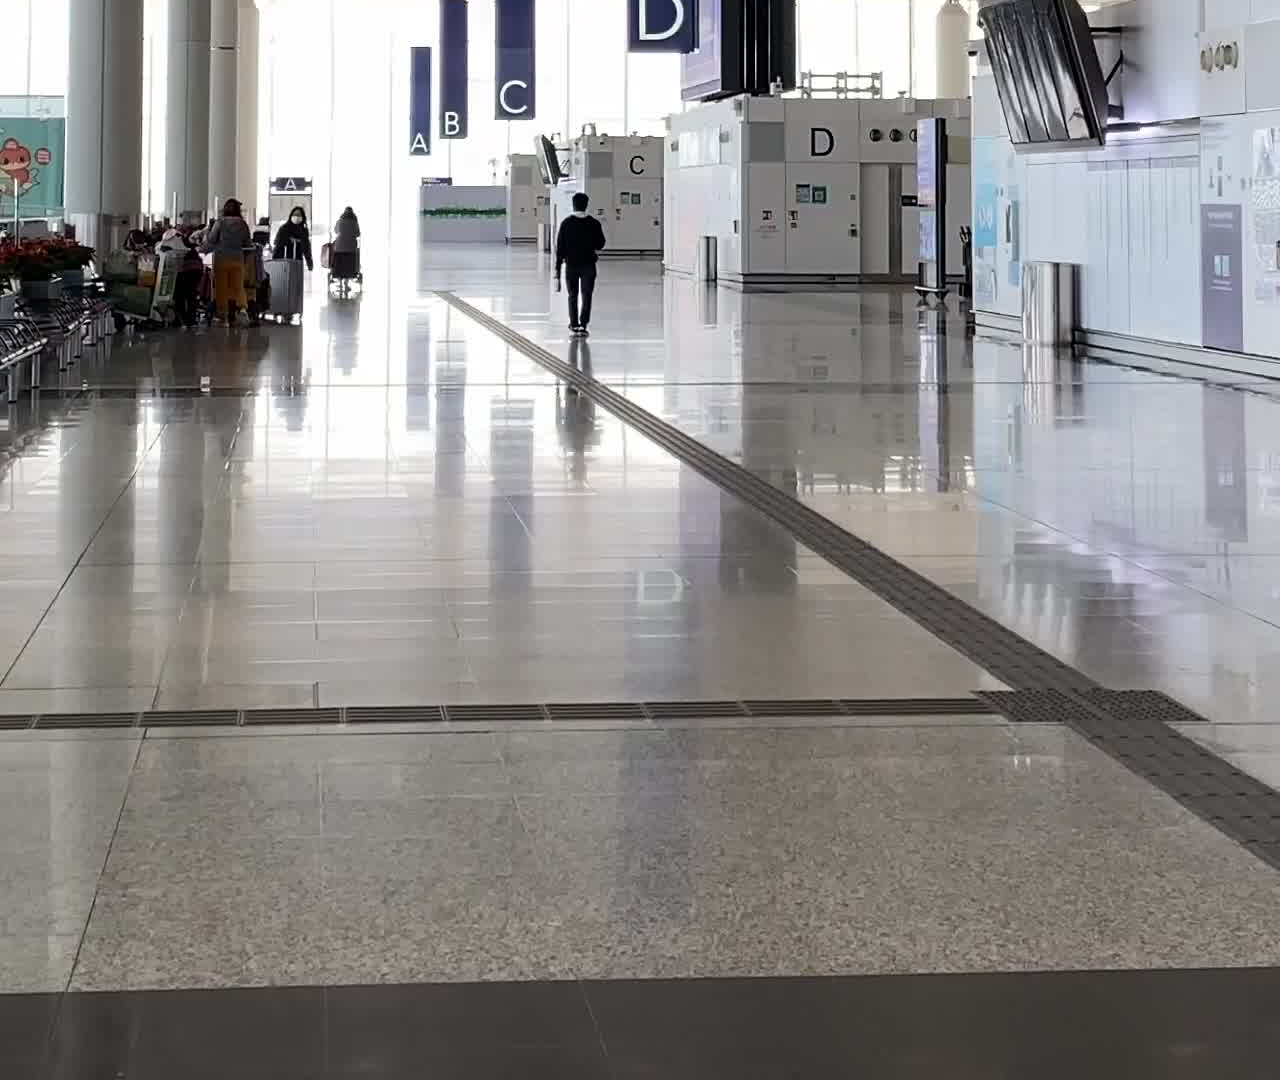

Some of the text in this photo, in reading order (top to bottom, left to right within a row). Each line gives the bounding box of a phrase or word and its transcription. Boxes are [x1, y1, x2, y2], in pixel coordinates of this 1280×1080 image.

[499, 80, 528, 114] C
[444, 111, 460, 136] B
[410, 133, 429, 153] A
[810, 127, 835, 157] D
[629, 155, 646, 176] C
[284, 178, 297, 190] A
